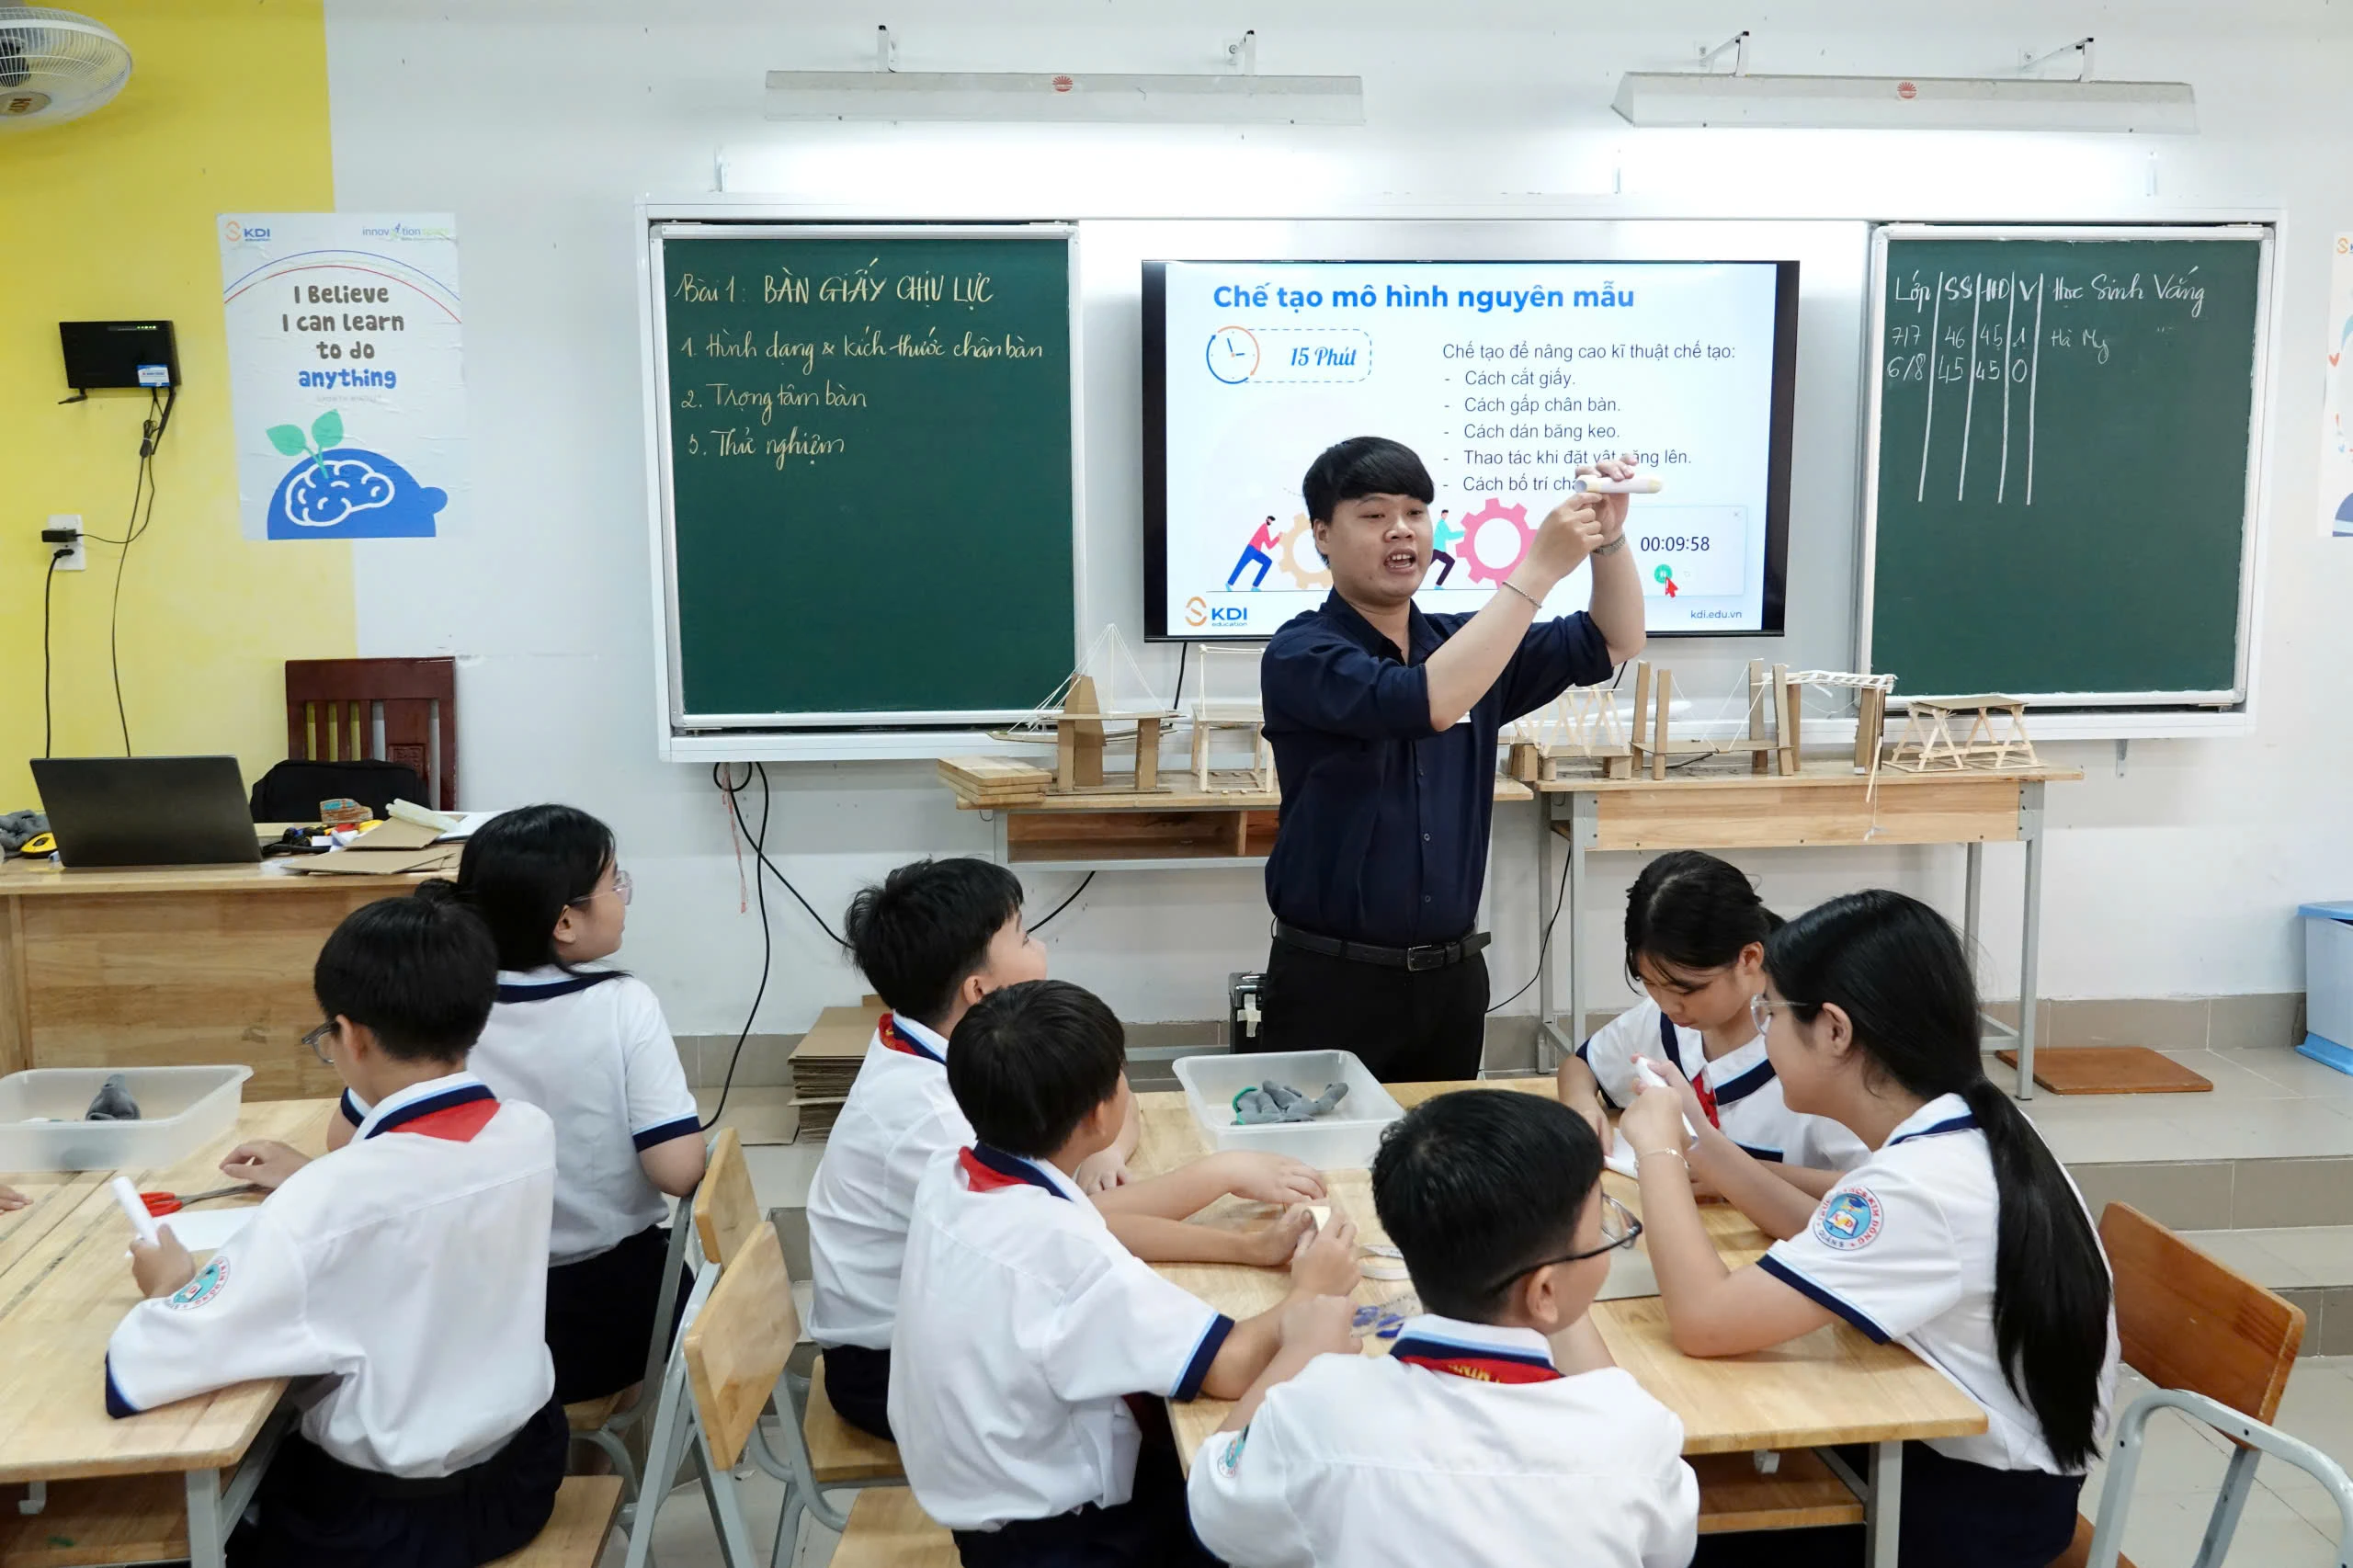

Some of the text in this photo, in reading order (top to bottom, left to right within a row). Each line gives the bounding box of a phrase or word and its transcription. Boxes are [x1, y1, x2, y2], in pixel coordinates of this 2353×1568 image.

[244, 228, 270, 238] KDI
[294, 285, 390, 304] I Believe
[674, 273, 719, 302] Bài
[765, 267, 809, 304] BÀN
[819, 257, 887, 302] GIẤY
[896, 270, 944, 308] CHỊU
[953, 272, 994, 311] LỰC
[1895, 269, 1931, 313] Lớp
[1944, 276, 1973, 301] SS
[2018, 280, 2039, 301] V
[2091, 272, 2144, 301] Sinh
[2154, 266, 2205, 318] Vắng
[1213, 280, 1634, 313] Chế tạo mô hình nguyên mẫu
[282, 313, 404, 332] I can learn
[1944, 325, 1965, 349] 46
[1980, 324, 2003, 347] 45
[2014, 326, 2026, 347] 1
[2052, 328, 2073, 347] Hà
[316, 341, 375, 359] to do
[706, 328, 757, 358] Hình
[766, 330, 814, 376] dạng
[822, 341, 835, 356] &
[844, 325, 887, 357] kích
[889, 326, 946, 358] thước
[953, 331, 1002, 358] chân
[1006, 334, 1042, 358] bàn
[1290, 346, 1358, 367] 15 Phút
[1443, 340, 1735, 362] Chế tạo để nâng cao kĩ thuật chế tạo:
[299, 368, 397, 390] anything
[1465, 367, 1575, 389] Cách cắt giấy.
[1887, 353, 2028, 384] 6/8 45 45 0
[681, 379, 868, 426] 2. Trọng tâm bàn
[1465, 394, 1620, 415] Cách gấp chân bàn.
[1464, 423, 1620, 442] Cách dán băng keo.
[710, 426, 756, 457] Thử
[766, 426, 845, 471] nghiệm
[1463, 449, 1504, 465] Thao
[1508, 449, 1530, 465] tác
[1537, 449, 1559, 464] khi
[1564, 449, 1588, 467] đặt
[1665, 449, 1692, 464] lên.
[1463, 476, 1504, 492] Cách
[1509, 473, 1529, 491] bố
[1533, 475, 1549, 491] trí
[1641, 536, 1711, 551] 00:09:58
[1211, 608, 1247, 620] KDI
[1690, 609, 1743, 619] kdi.edu.vn
